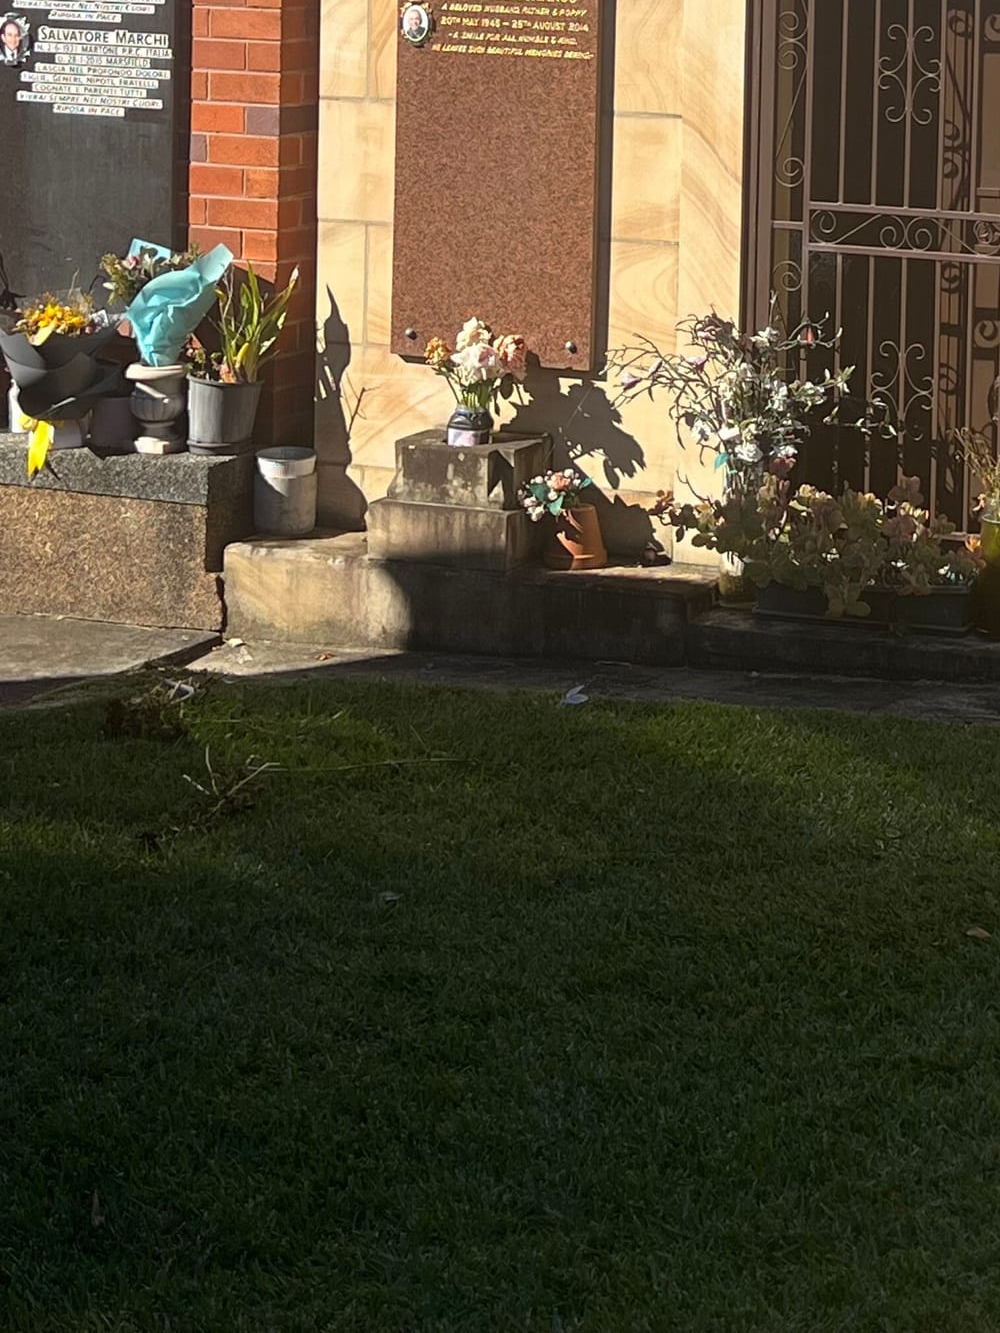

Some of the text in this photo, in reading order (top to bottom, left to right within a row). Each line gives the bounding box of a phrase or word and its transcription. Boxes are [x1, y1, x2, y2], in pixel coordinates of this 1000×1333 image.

[462, 17, 480, 26] MAY
[532, 21, 565, 31] AUGUST
[41, 28, 166, 46] SALVATORE MARCHI
